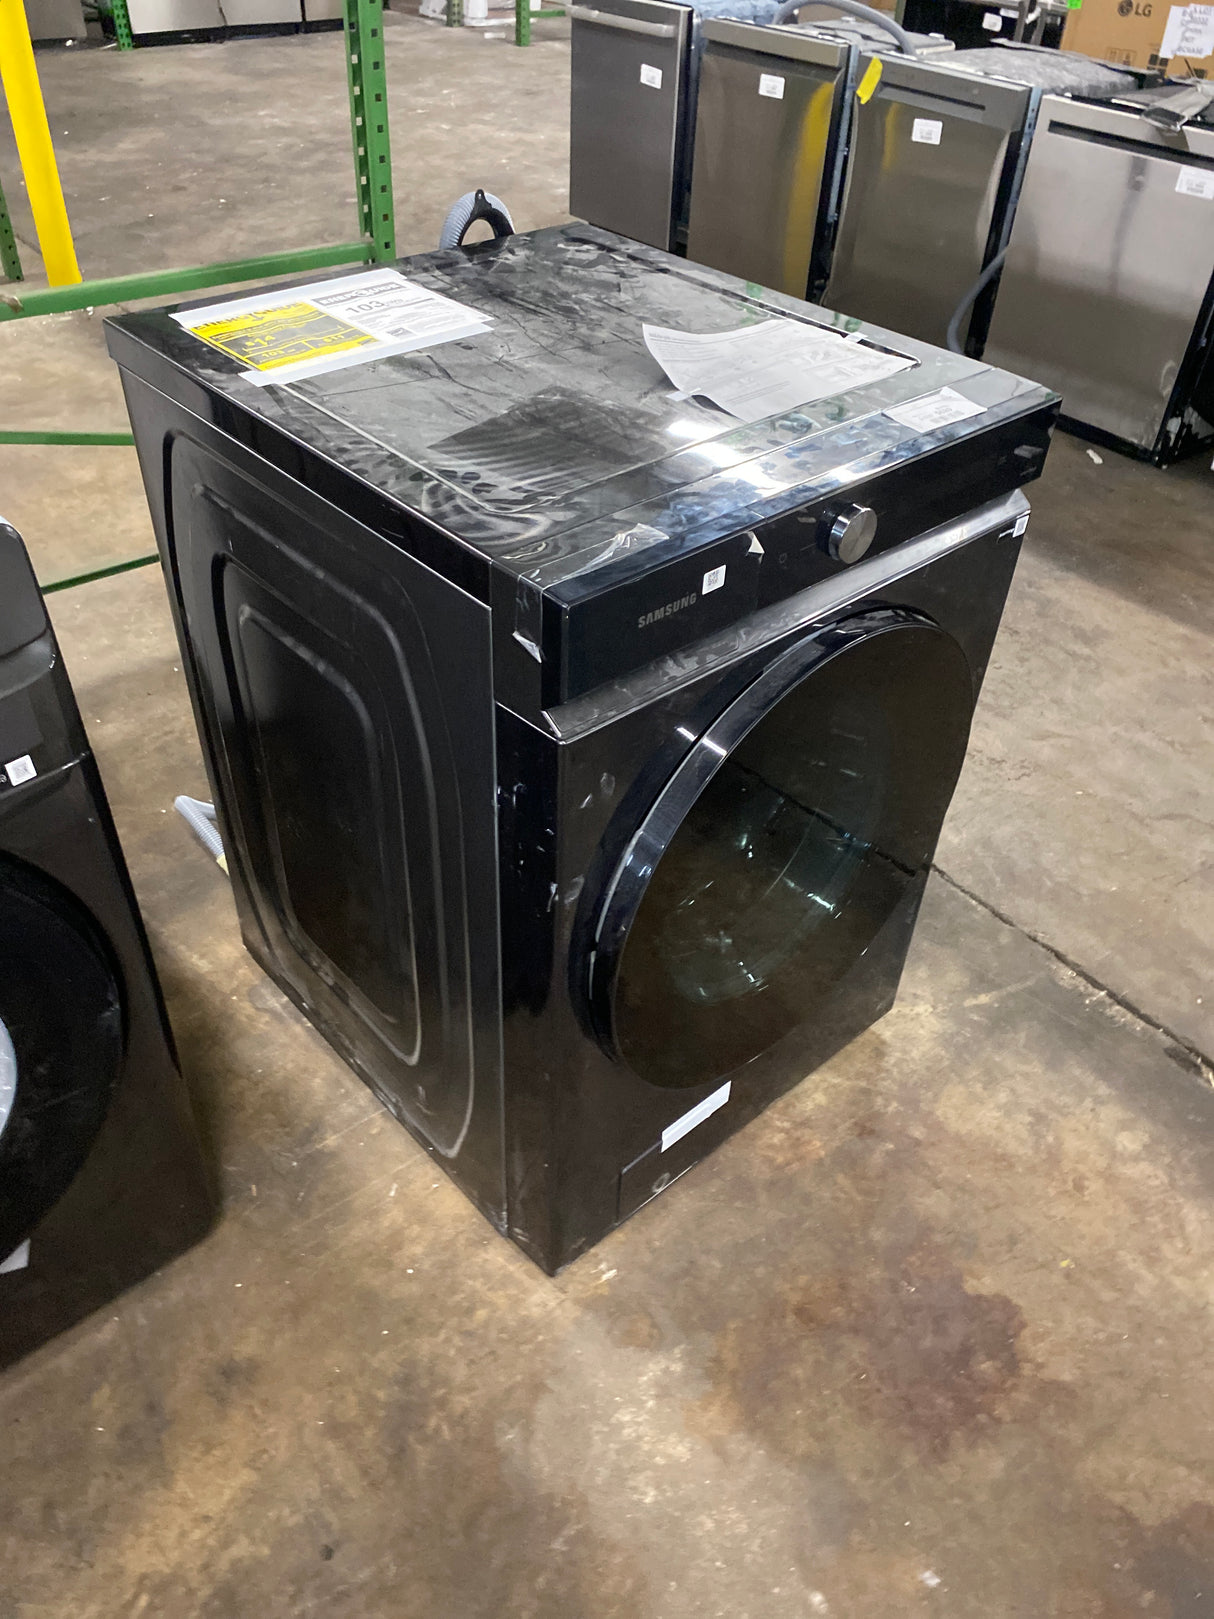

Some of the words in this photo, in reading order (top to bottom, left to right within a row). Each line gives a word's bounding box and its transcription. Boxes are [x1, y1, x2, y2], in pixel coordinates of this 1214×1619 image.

[1134, 4, 1152, 17] LG
[345, 301, 385, 314] 103
[637, 592, 697, 628] SAMSUNG
